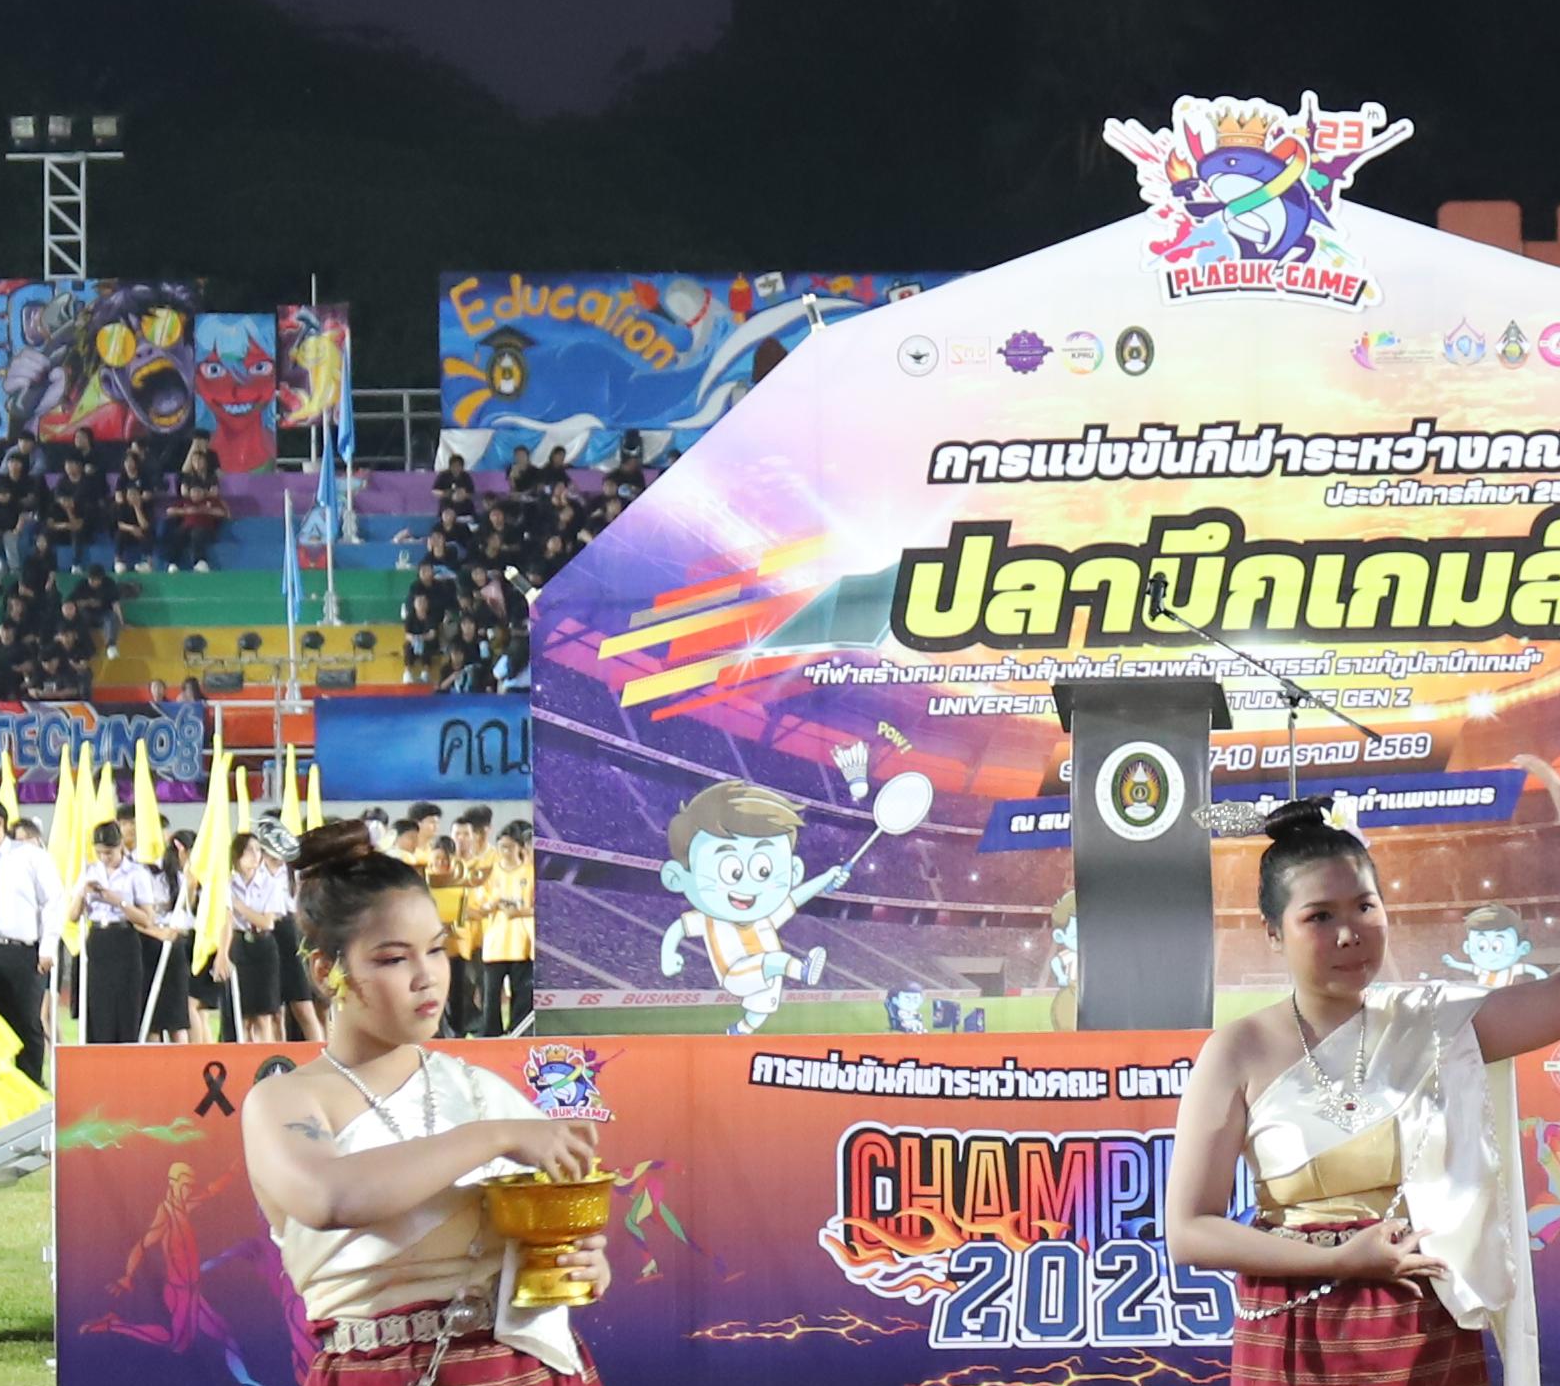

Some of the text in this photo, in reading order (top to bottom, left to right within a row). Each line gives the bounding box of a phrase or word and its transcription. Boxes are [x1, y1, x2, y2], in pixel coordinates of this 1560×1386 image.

[1175, 261, 1359, 298] PLABUK GAME
[449, 274, 677, 370] Education
[1325, 478, 1530, 507] ประจำปีการศึกษา
[1342, 689, 1393, 708] GEN
[1394, 687, 1412, 706] Z
[876, 721, 913, 755] POW!
[1261, 742, 1357, 768] มกราคม
[1366, 734, 1431, 760] 2569
[578, 993, 602, 1005] BS
[622, 992, 702, 1004] BUSINESS
[770, 996, 778, 1007] 9
[752, 1051, 1107, 1098] การแข่งขันกีฬาระหว่างคณะ
[942, 1241, 1237, 1347] 2025
